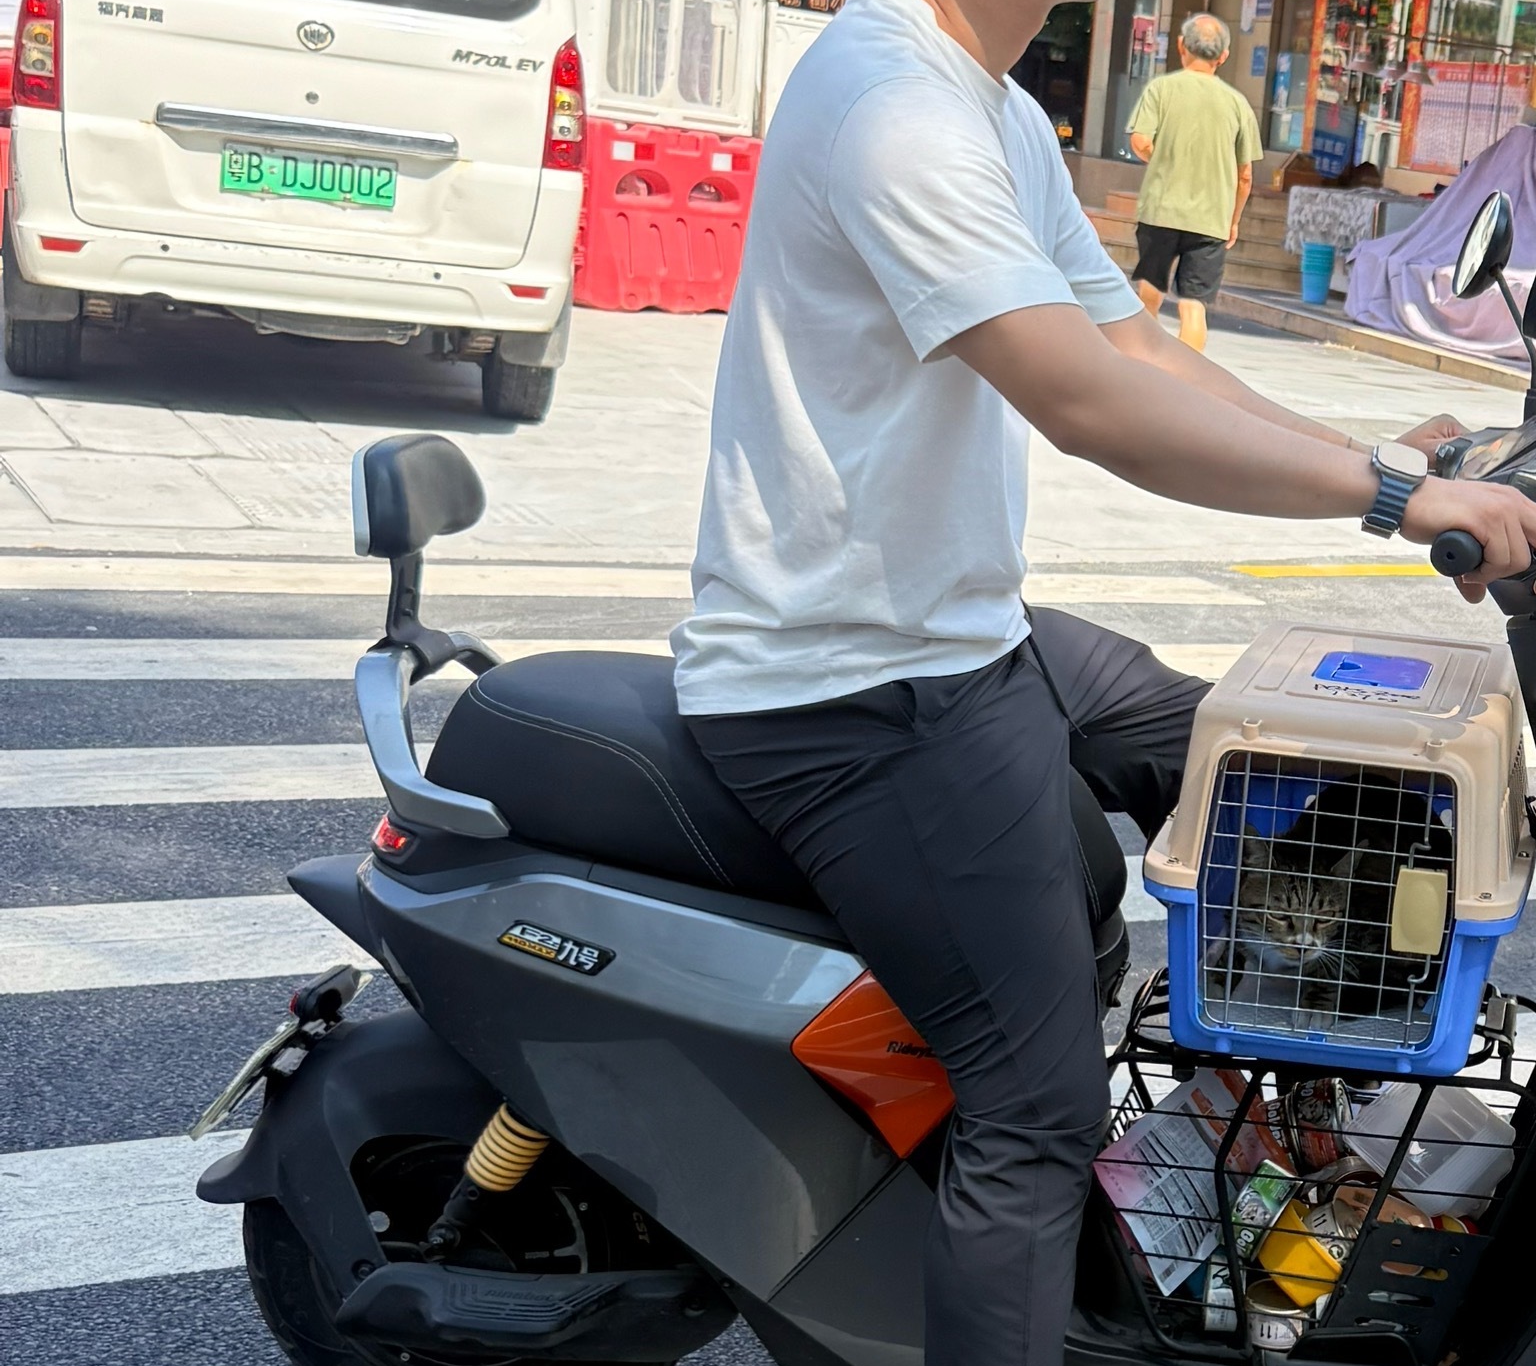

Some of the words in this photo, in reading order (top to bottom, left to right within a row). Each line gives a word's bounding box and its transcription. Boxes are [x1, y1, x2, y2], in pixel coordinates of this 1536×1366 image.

[452, 49, 512, 69] M70L
[516, 58, 545, 73] EV
[558, 940, 600, 971] 九号
